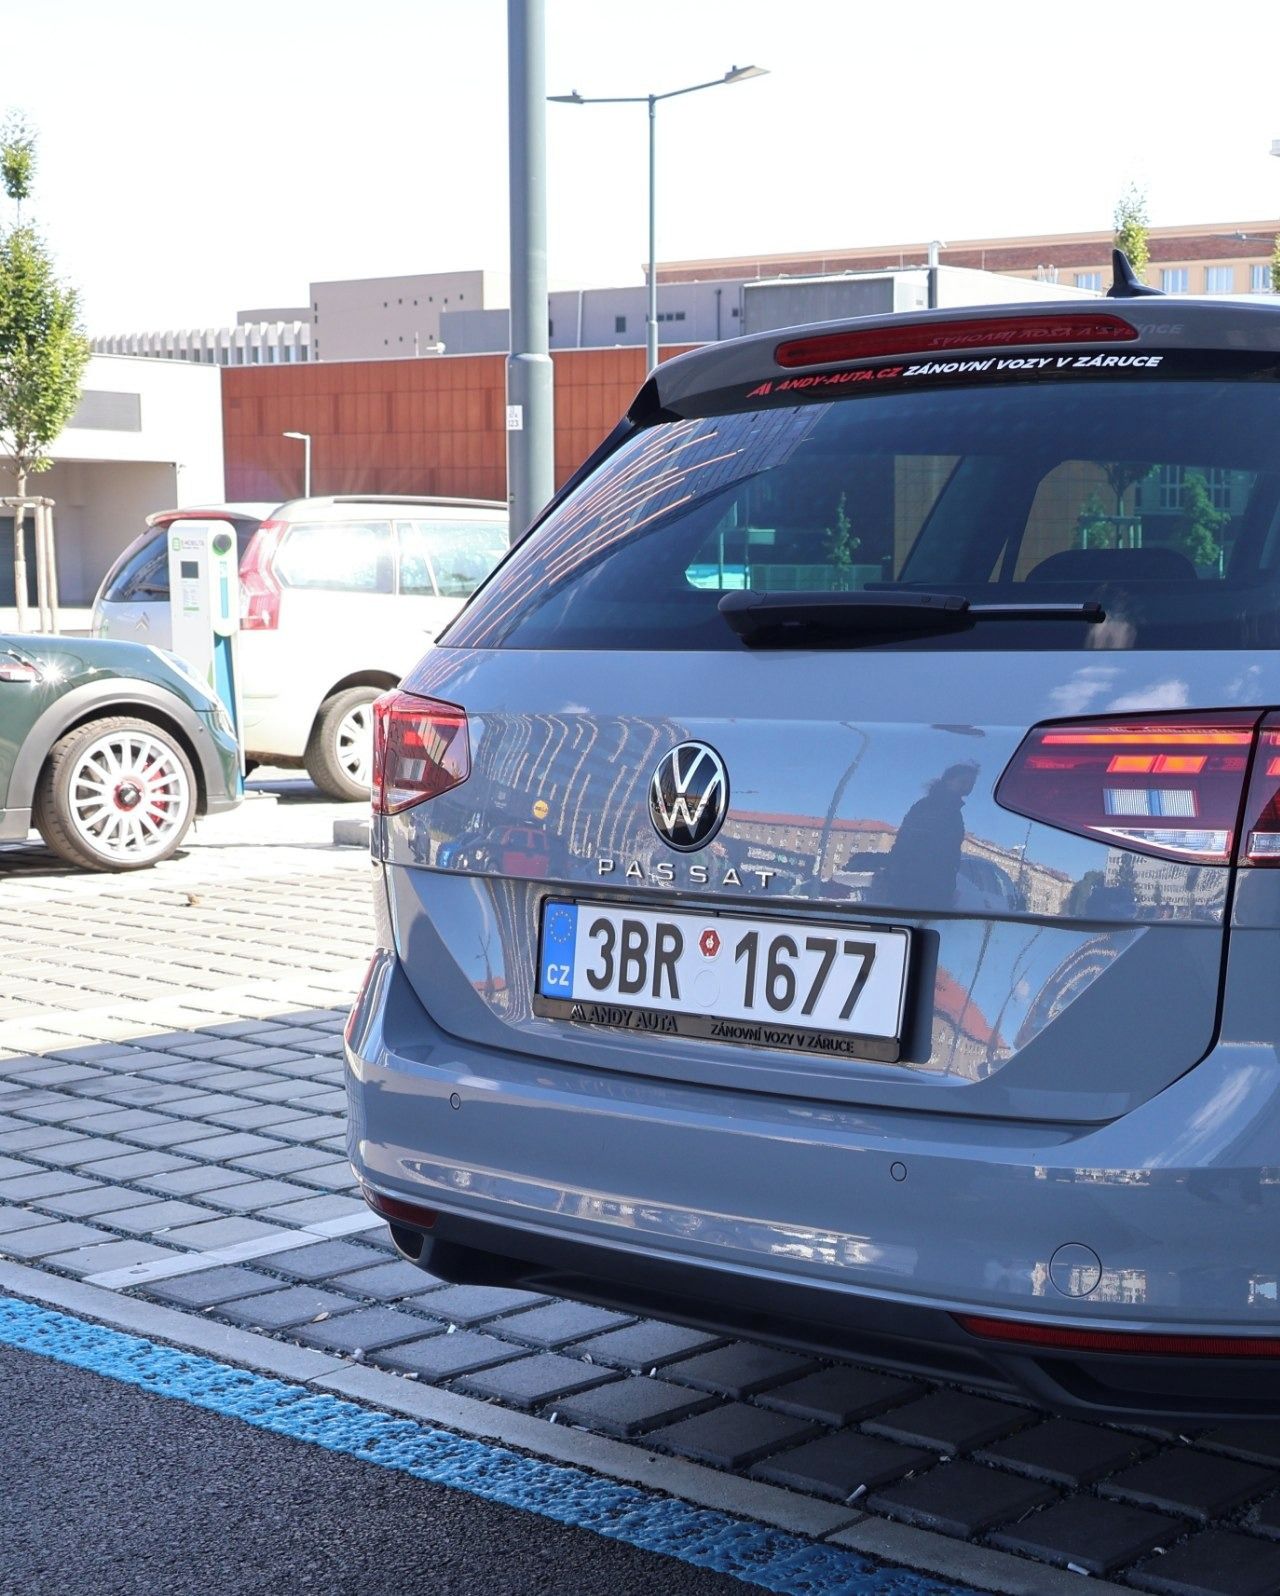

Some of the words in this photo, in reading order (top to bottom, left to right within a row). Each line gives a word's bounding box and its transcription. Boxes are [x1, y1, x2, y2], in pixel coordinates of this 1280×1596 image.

[775, 367, 903, 391] ANDY-AUTA.CZ
[902, 357, 997, 377] ZÁNOVNÍ
[997, 357, 1053, 370] VOZY
[1056, 357, 1072, 368] V
[1073, 354, 1163, 367] ZÁRUCE
[598, 858, 777, 889] PASSAT
[547, 963, 570, 987] CZ
[586, 917, 685, 1000] 3BR
[733, 930, 877, 1021] 1677
[589, 1006, 633, 1026] ANDY
[636, 1012, 678, 1032] AUTA
[711, 1022, 761, 1041] ZÁNOVNÍ
[764, 1030, 795, 1045] VOZY
[797, 1035, 805, 1047] V
[807, 1034, 855, 1053] ZÁRUCE
